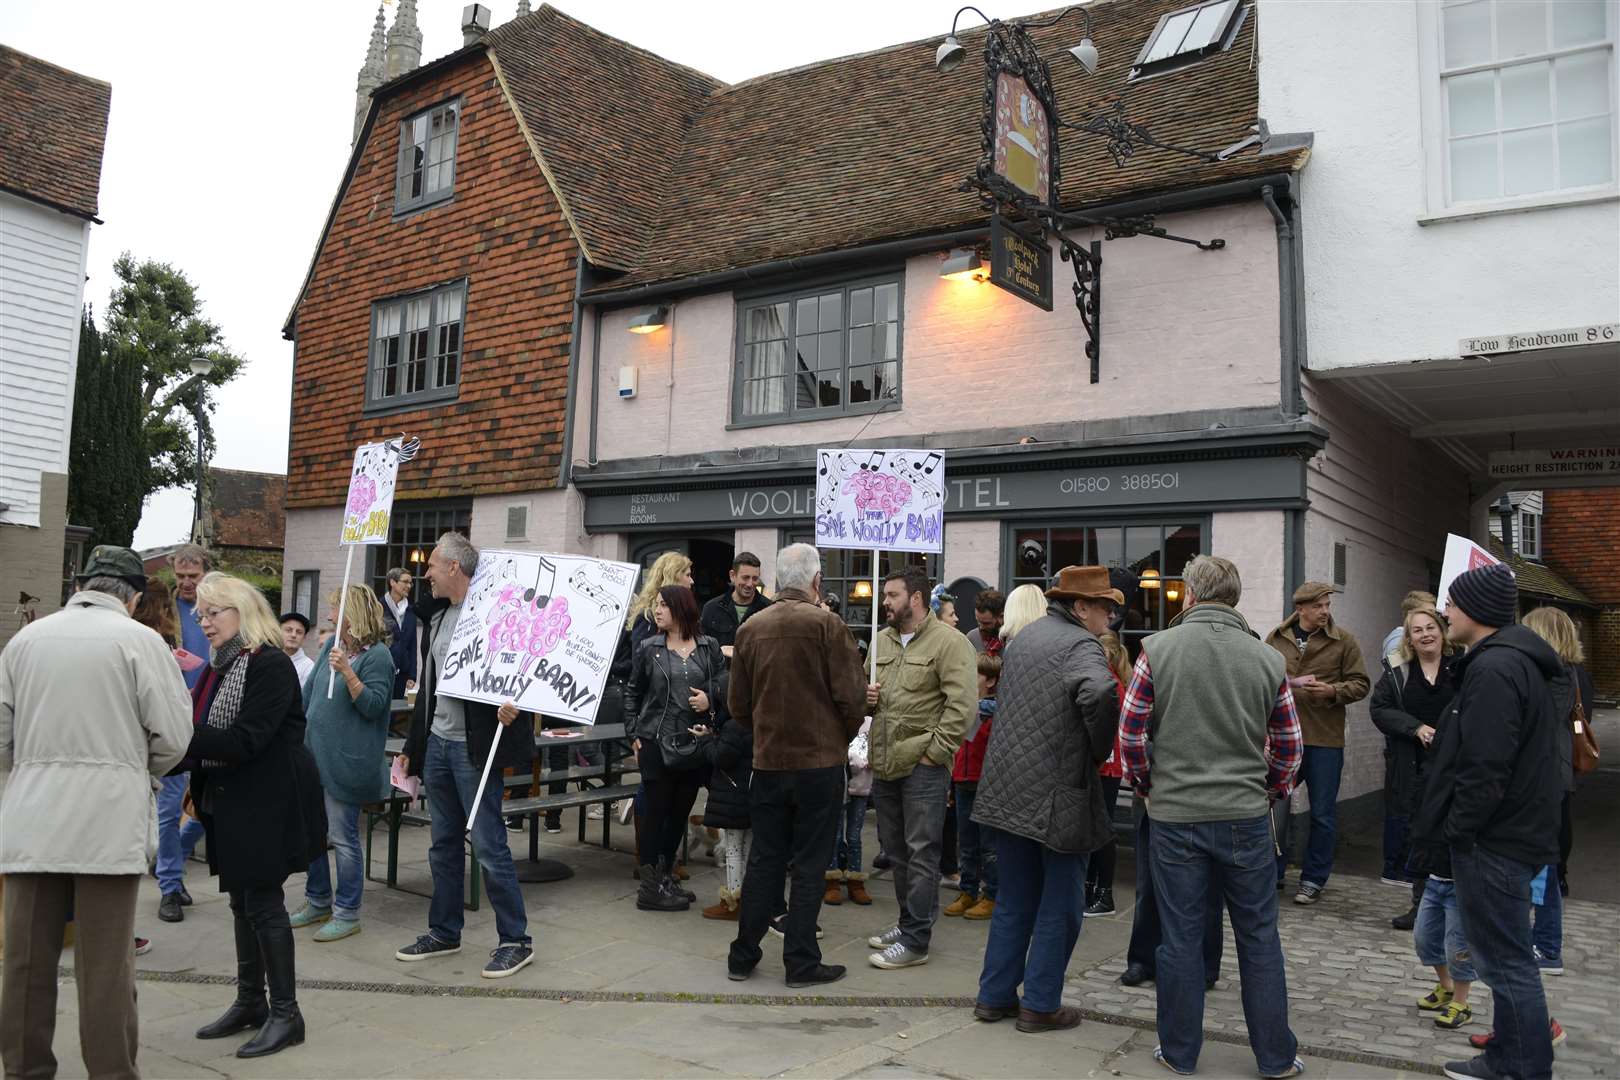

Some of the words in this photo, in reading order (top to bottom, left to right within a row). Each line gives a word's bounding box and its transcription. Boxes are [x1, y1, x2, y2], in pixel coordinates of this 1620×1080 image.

[1468, 339, 1499, 352] Low
[1508, 332, 1579, 351] Headroom
[1551, 448, 1620, 460] WARNIN
[1491, 463, 1530, 475] HEIGHT
[1535, 461, 1604, 473] RESTRICTION
[1060, 476, 1111, 493] 01580
[1121, 472, 1179, 490] 388501
[631, 492, 681, 504] RESTAURANT
[943, 478, 1010, 508] TEL
[630, 505, 647, 515] BAR
[630, 514, 657, 524] ROOMS
[816, 512, 847, 538] SAVE
[851, 519, 904, 545] WOOLLY
[905, 509, 942, 543] BARN
[443, 634, 485, 680] SAVE
[500, 652, 518, 664] THE
[469, 667, 533, 702] WOOLLY
[534, 658, 598, 713] BARN!
